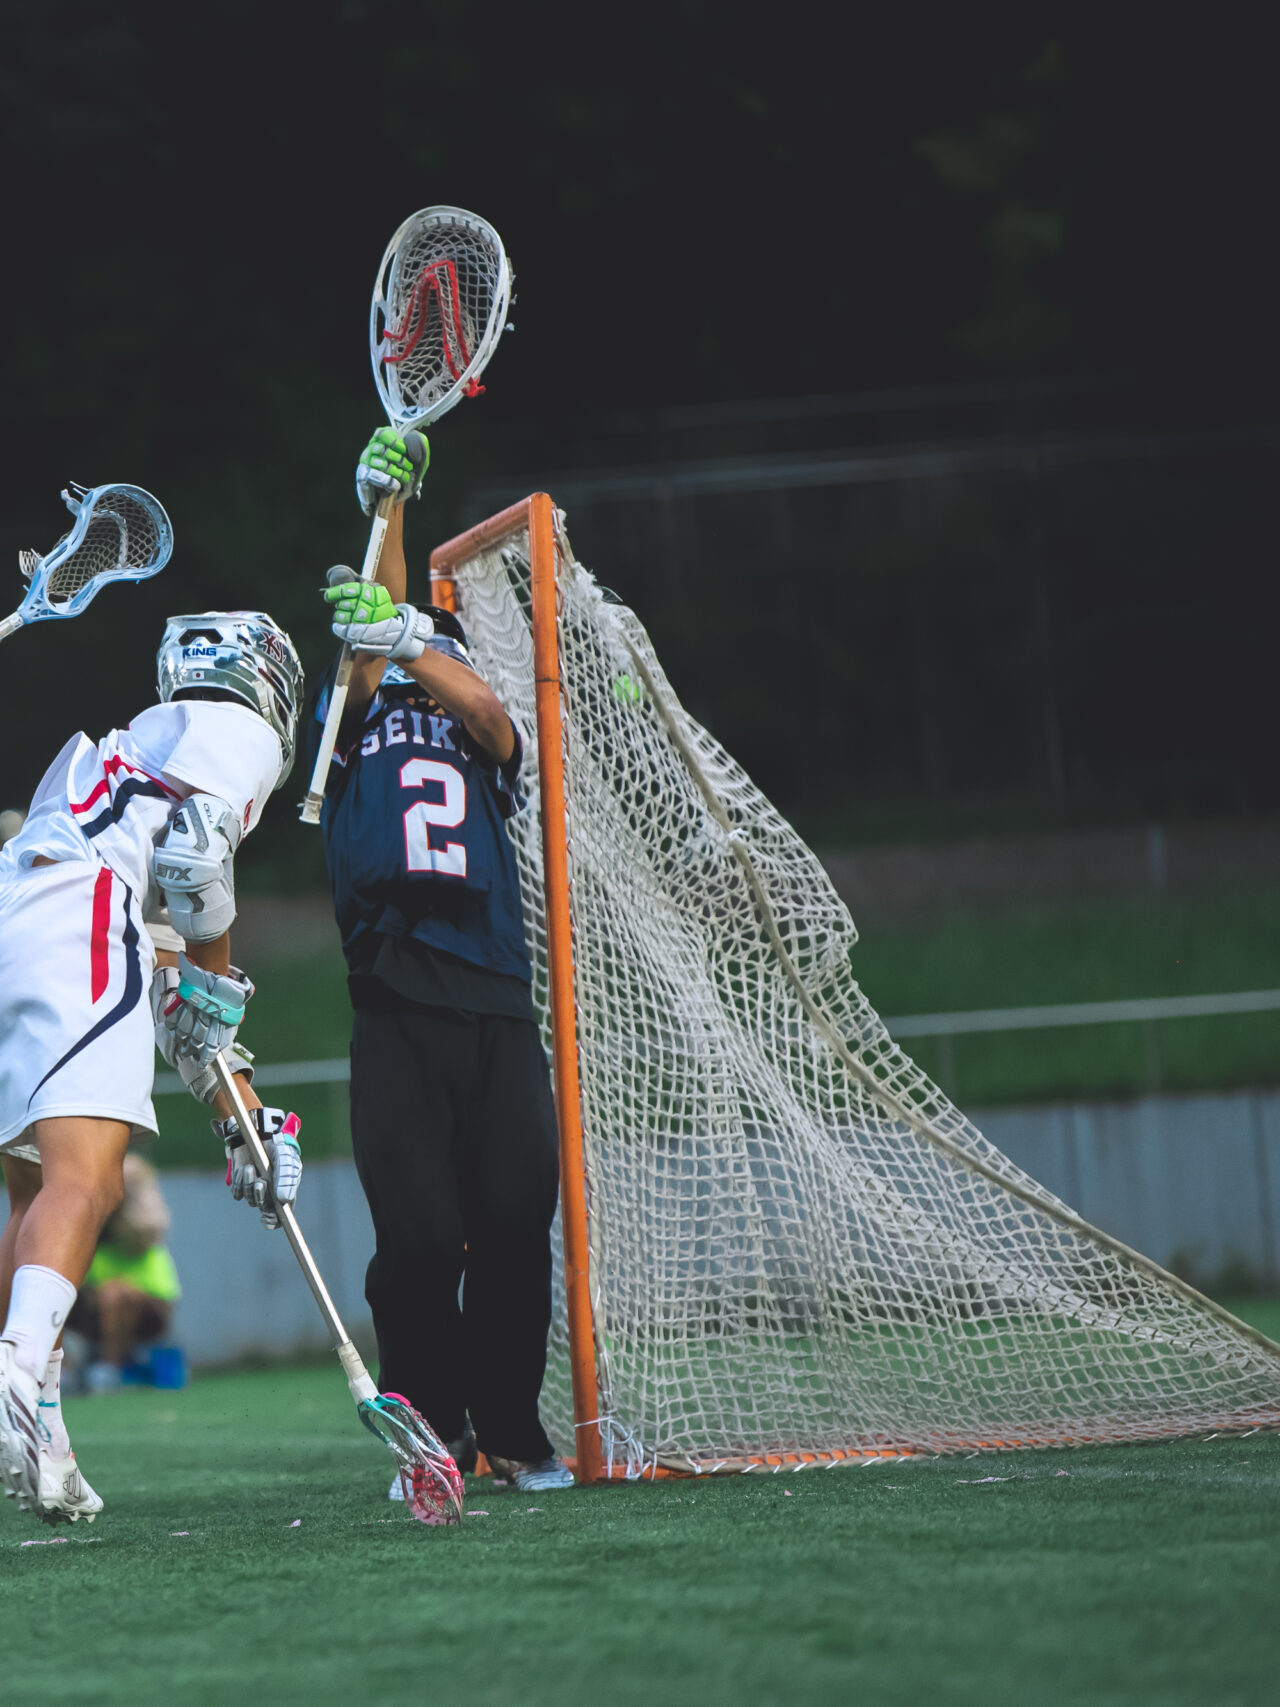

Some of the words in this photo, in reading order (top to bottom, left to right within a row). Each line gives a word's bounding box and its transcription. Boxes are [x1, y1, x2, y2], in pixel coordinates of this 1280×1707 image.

[183, 647, 217, 658] KING
[360, 708, 471, 762] SEIK
[399, 757, 467, 879] 2
[156, 864, 193, 882] STX
